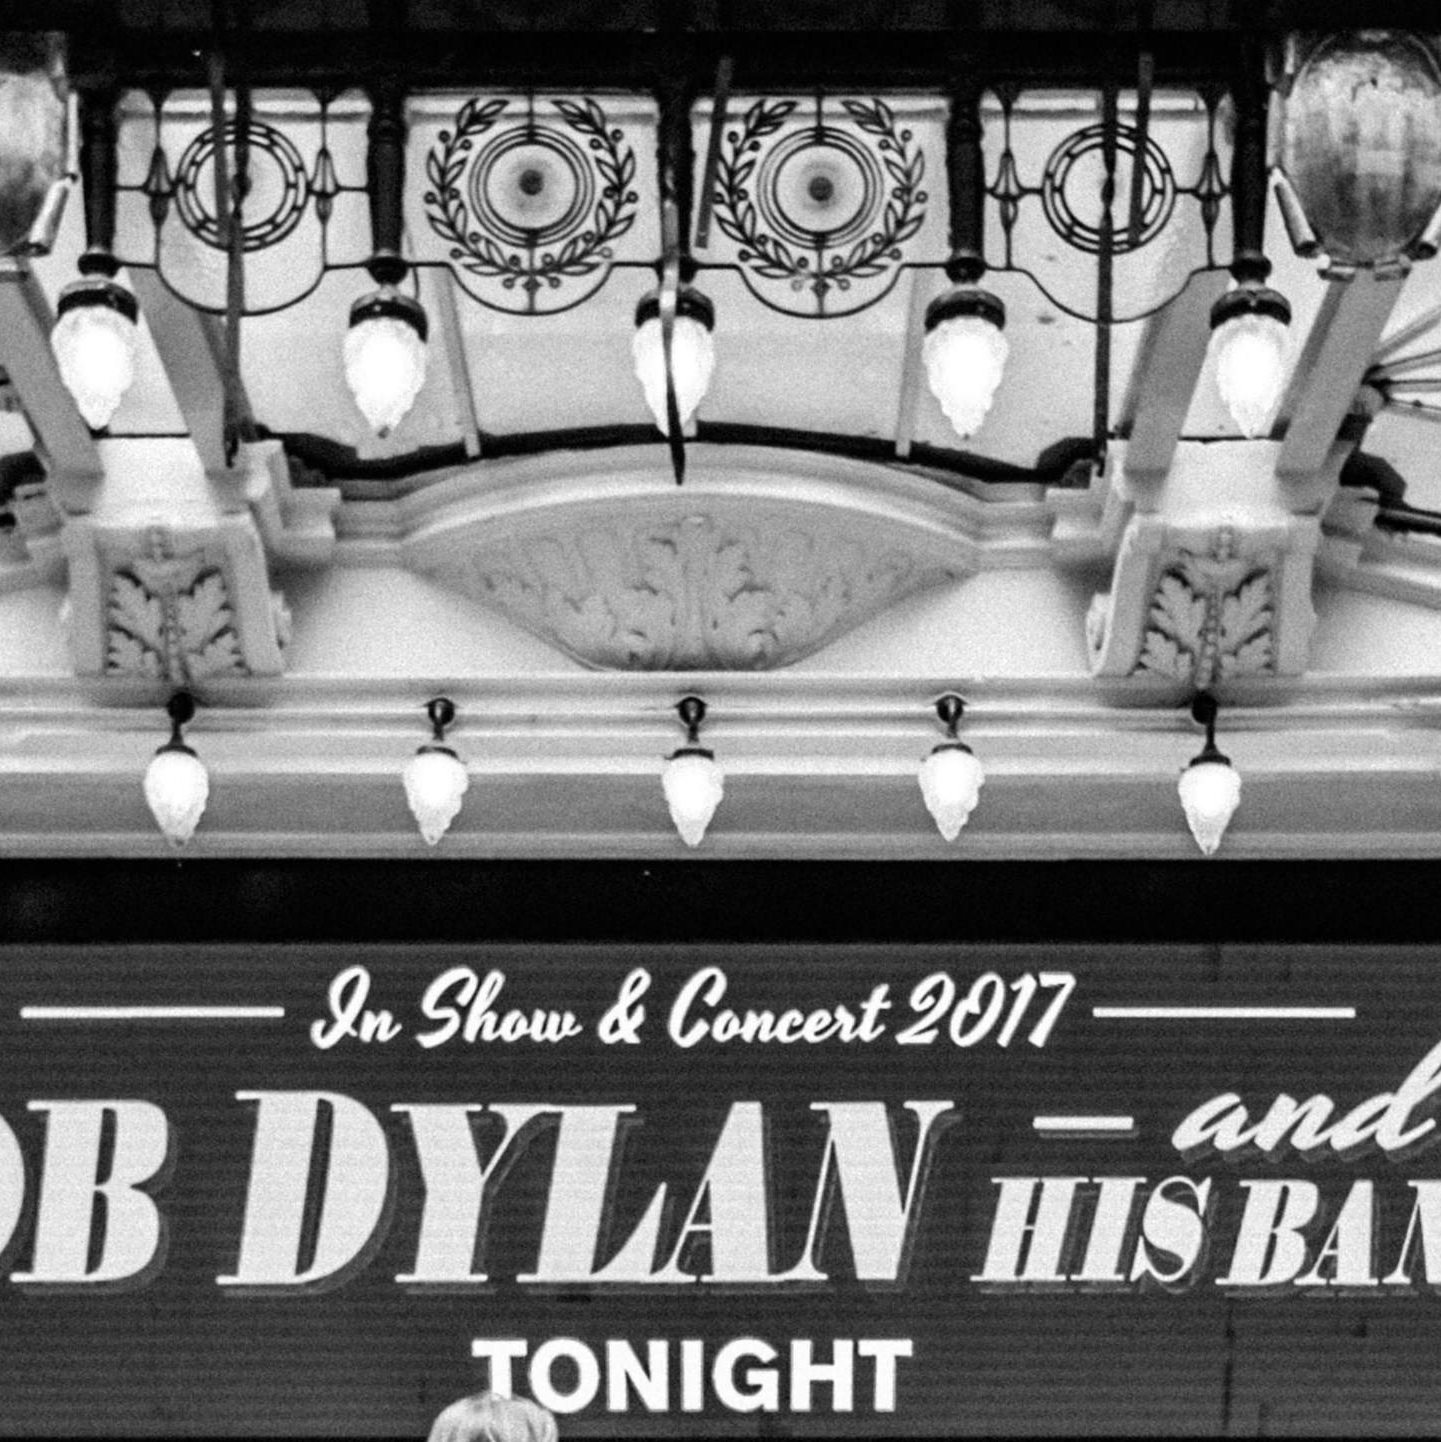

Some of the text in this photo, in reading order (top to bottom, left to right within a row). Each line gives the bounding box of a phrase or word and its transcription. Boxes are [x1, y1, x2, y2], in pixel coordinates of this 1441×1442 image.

[310, 966, 1076, 1050] In Show & Concert 2017
[215, 1090, 955, 1285] DYLAN
[969, 1175, 1212, 1284] HIS
[470, 1337, 914, 1413] TONIGHT
